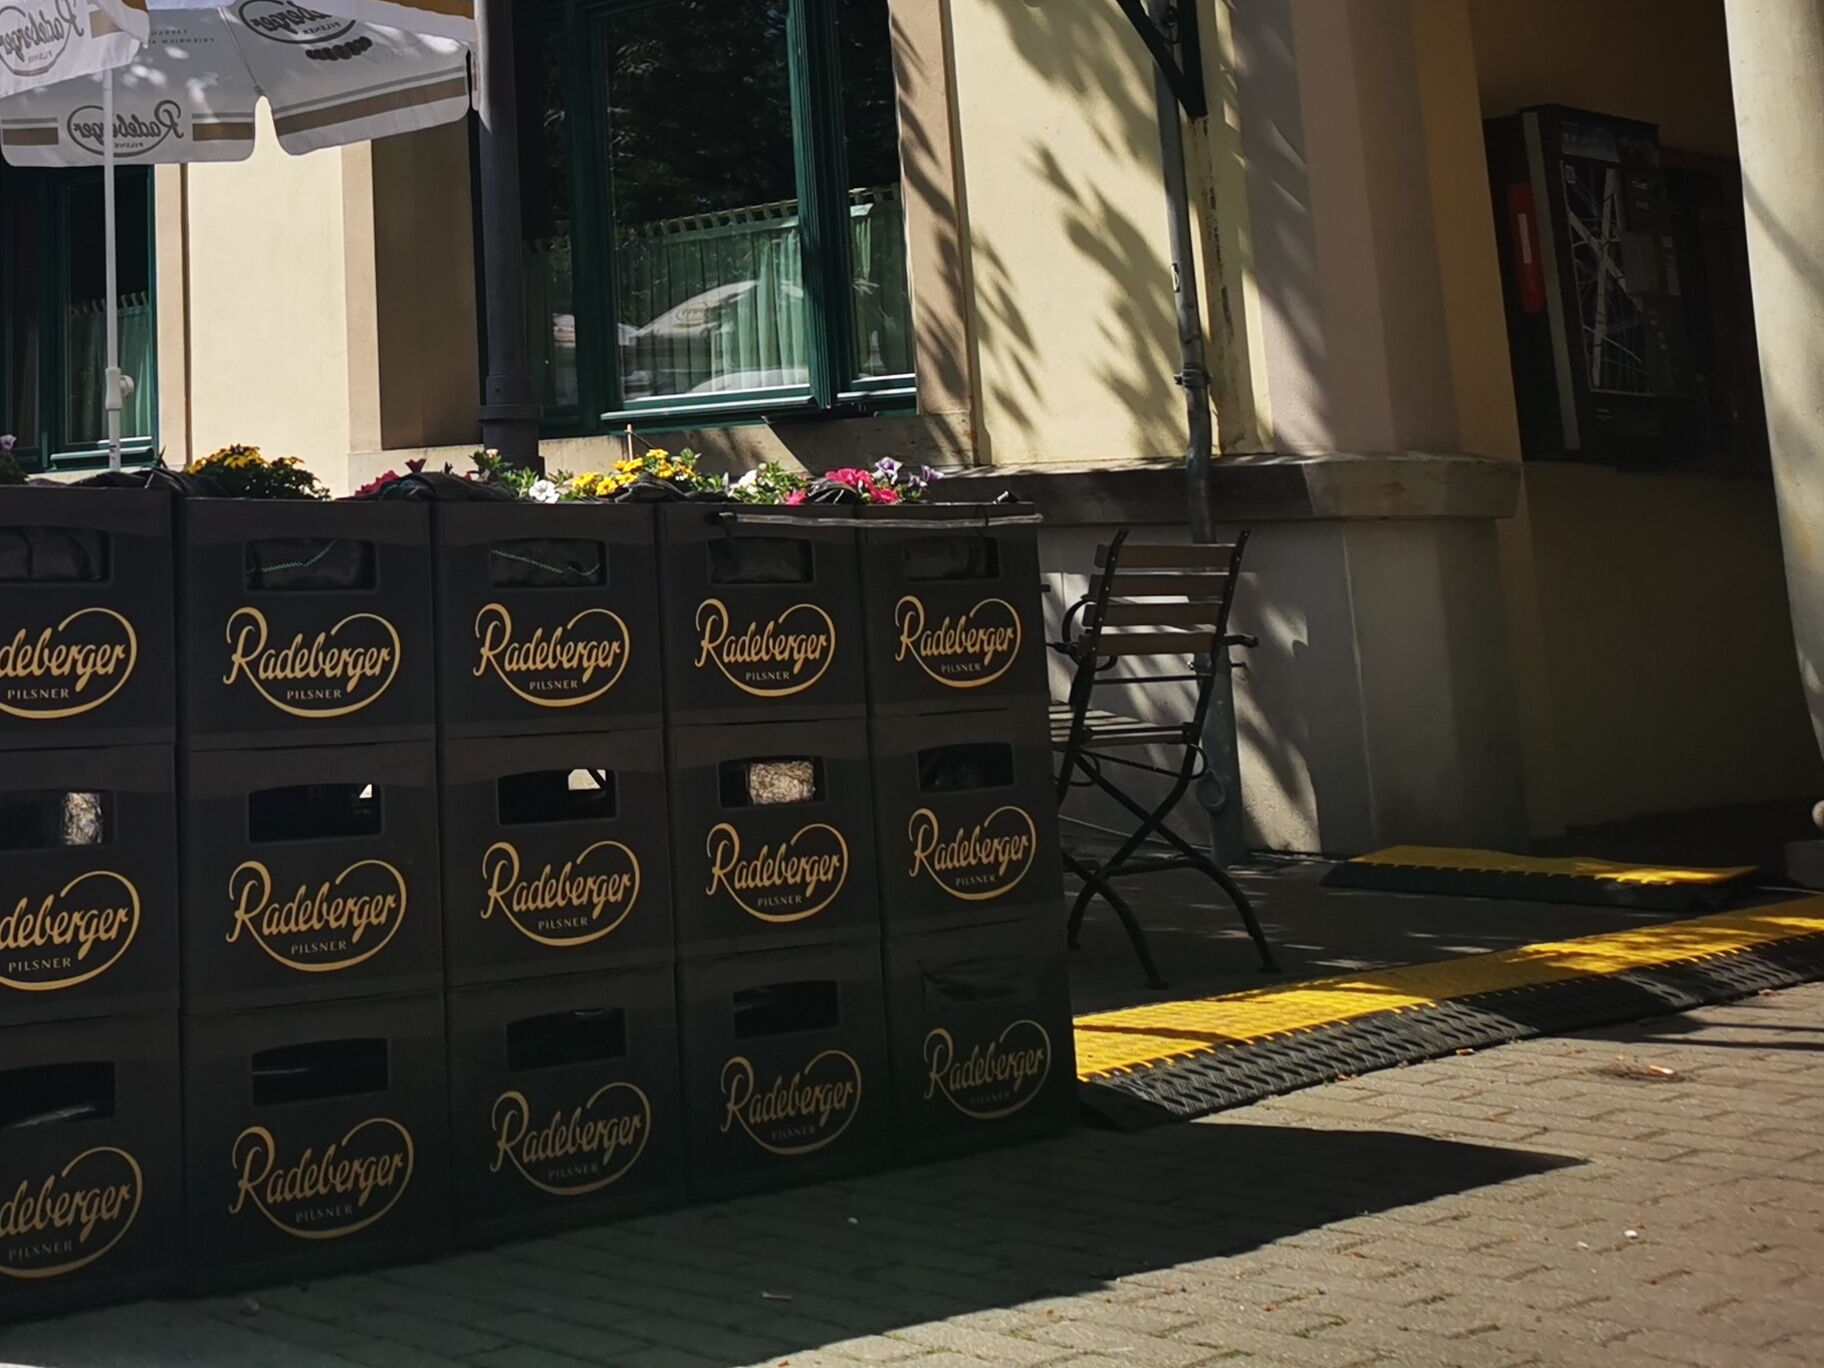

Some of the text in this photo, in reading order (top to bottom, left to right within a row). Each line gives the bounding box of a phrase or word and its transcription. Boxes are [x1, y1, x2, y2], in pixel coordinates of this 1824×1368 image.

[694, 597, 828, 675] Radeberger
[894, 594, 1015, 667] Radeberger
[222, 606, 392, 693] Radeberger
[472, 602, 622, 684] Radeberger
[745, 670, 790, 682] PILSNER
[941, 662, 981, 674] PILSNER
[7, 688, 69, 701] PILSNER
[286, 688, 342, 701] PILSNER
[529, 679, 578, 691] PILSNER
[908, 807, 1029, 877] Radeberger
[705, 822, 841, 898] Radeberger
[480, 841, 632, 920] Radeberger
[955, 873, 996, 887] PILSNER
[225, 860, 398, 944] Radeberger
[757, 894, 802, 908] PILSNER
[538, 916, 588, 931] PILSNER
[290, 939, 347, 956] PILSNER
[8, 956, 72, 974] PILSNER
[923, 1027, 1044, 1100] Radeberger
[719, 1055, 854, 1132] Radeberger
[489, 1090, 643, 1173] Radeberger
[228, 1125, 405, 1214] Radeberger
[548, 1161, 599, 1181] PILSNER
[295, 1203, 353, 1224] PILSNER
[8, 1239, 73, 1262] PILSNER
